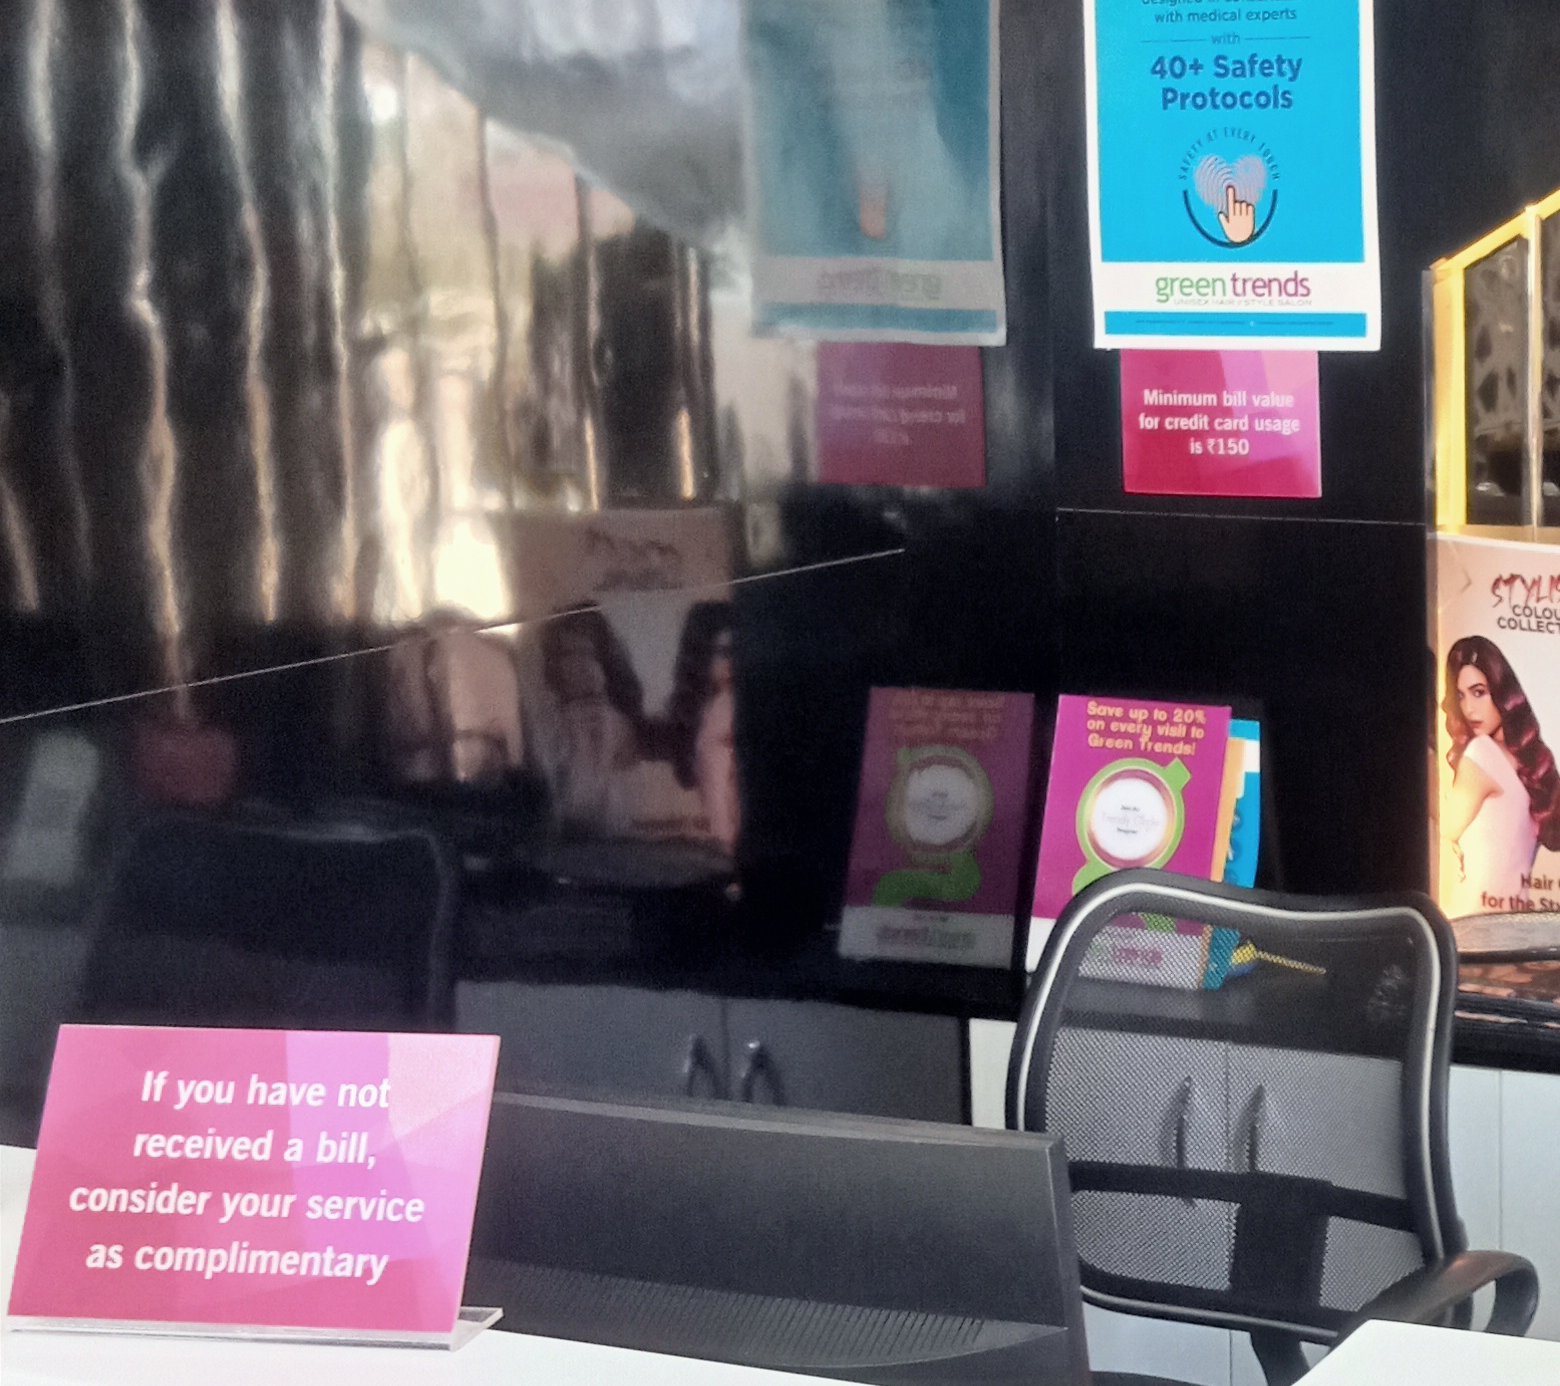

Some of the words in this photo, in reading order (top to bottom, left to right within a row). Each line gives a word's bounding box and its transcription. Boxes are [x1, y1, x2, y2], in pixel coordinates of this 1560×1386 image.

[1154, 10, 1183, 24] with
[1187, 9, 1241, 23] medical
[1246, 7, 1297, 23] experts
[1211, 32, 1241, 45] with
[1149, 55, 1204, 80] 40+
[1213, 53, 1303, 82] Safety
[1161, 84, 1294, 111] Protocols
[1155, 275, 1227, 303] green
[1231, 270, 1312, 298] trends
[1143, 388, 1218, 408] Minimum
[1222, 389, 1247, 408] bill
[1252, 391, 1294, 408] value
[1139, 413, 1161, 430] for
[1164, 413, 1209, 431] credit
[1214, 414, 1249, 432] card
[1254, 417, 1301, 436] usage
[1189, 438, 1203, 455] is
[1087, 700, 1124, 718] Save
[1128, 708, 1149, 723] up
[1153, 708, 1168, 722] to
[1173, 708, 1207, 724] 20%
[1087, 719, 1106, 730] on
[1109, 721, 1152, 740] every
[1157, 722, 1187, 738] visit
[1191, 725, 1205, 739] to
[1088, 733, 1134, 750] Green
[1139, 738, 1197, 755] Trends!
[1520, 873, 1554, 891] Hair
[1481, 891, 1504, 910] for
[1508, 894, 1536, 911] the
[141, 1069, 169, 1103] If
[173, 1075, 235, 1110] you
[247, 1072, 327, 1108] have
[337, 1077, 391, 1109] not
[132, 1127, 274, 1163] received
[283, 1136, 304, 1163] a
[316, 1131, 377, 1170] bill,
[69, 1181, 213, 1216] consider
[218, 1190, 298, 1224] your
[305, 1189, 426, 1223] service
[85, 1241, 123, 1270] as
[134, 1241, 389, 1286] complimentary
